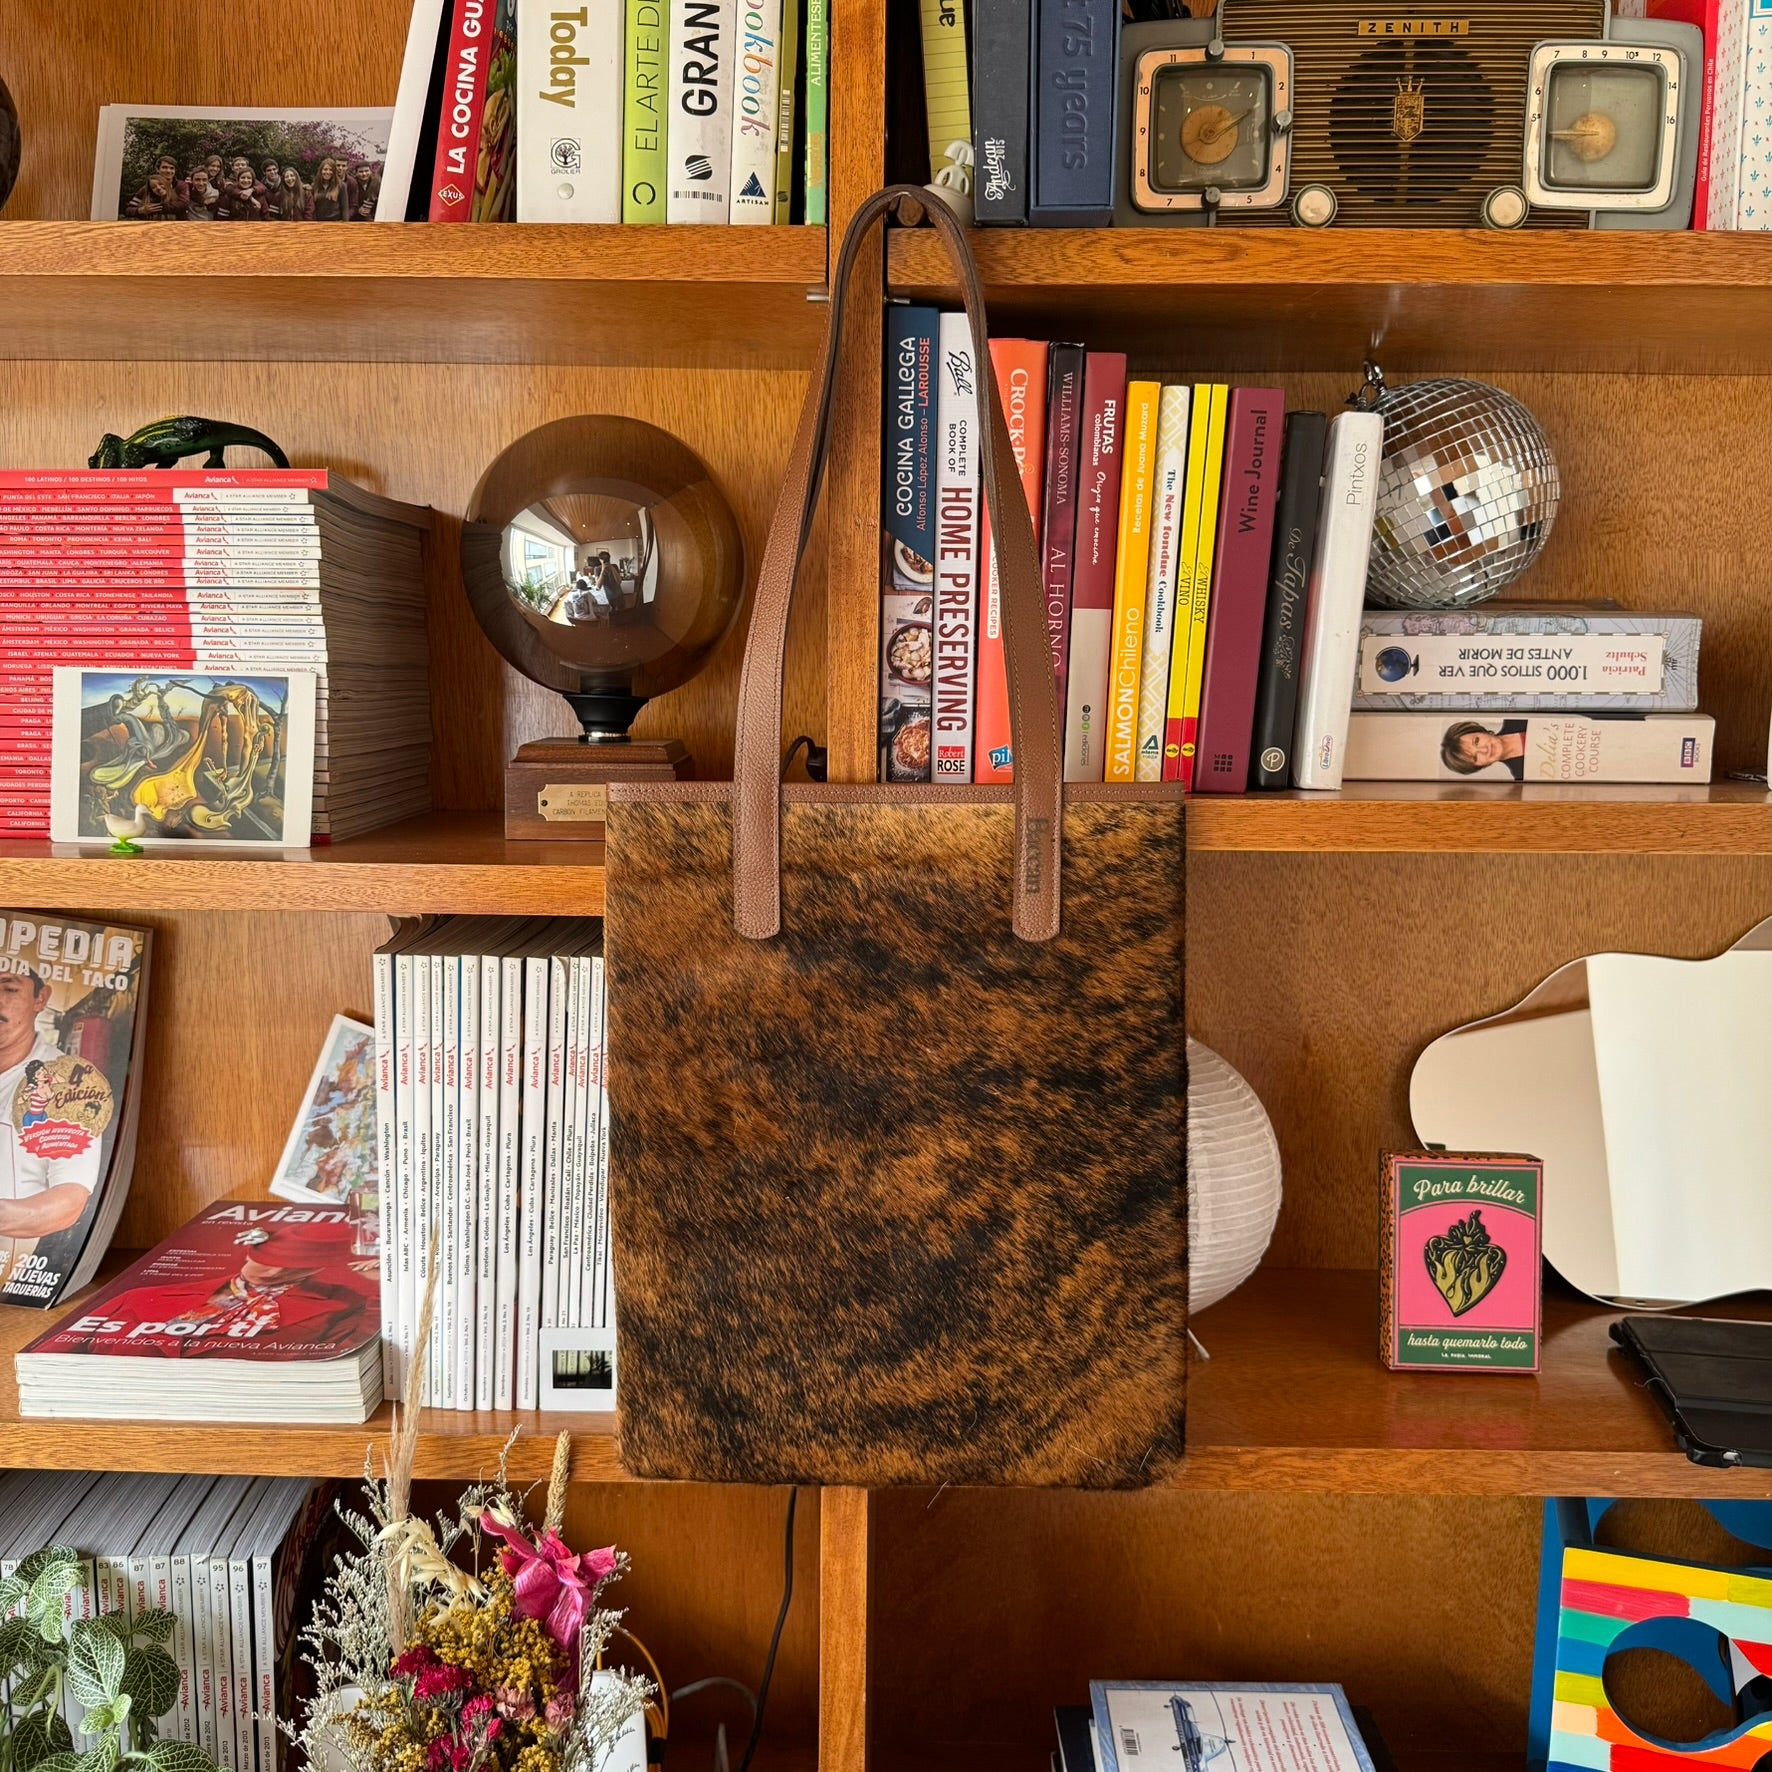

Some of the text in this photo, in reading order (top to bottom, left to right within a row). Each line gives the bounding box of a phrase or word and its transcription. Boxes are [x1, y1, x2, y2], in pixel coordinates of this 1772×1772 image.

[1368, 22, 1461, 33] ZENITH
[539, 6, 590, 109] Today
[681, 2, 720, 117] GRAN
[1170, 54, 1177, 62] 11
[1582, 50, 1588, 58] 8
[1601, 50, 1608, 58] 9
[1652, 53, 1662, 61] 12
[447, 0, 484, 175] LA COCINA GU
[635, 0, 660, 151] EL ARTE D
[1278, 82, 1285, 90] 2
[1668, 81, 1677, 90] 14
[1052, 15, 1094, 171] 75 years
[1140, 87, 1150, 95] 10
[1535, 87, 1541, 95] 6
[1139, 127, 1146, 137] 9
[1666, 115, 1675, 124] 16
[995, 139, 1006, 160] 2015
[983, 137, 1016, 201] Andean
[1139, 168, 1145, 177] 8
[1275, 164, 1281, 173] 4
[1166, 198, 1173, 206] 7
[1246, 195, 1252, 204] 5
[946, 350, 973, 397] Ball
[916, 337, 930, 531] Alfonso López Alonso LAROUSSE
[1010, 368, 1029, 475] CROCK·P
[1102, 400, 1116, 454] FRUTAS
[948, 423, 957, 473] BOOK OF
[958, 419, 967, 476] COMPLETE
[1056, 372, 1073, 505] WILLIAMS-SONOMA
[1092, 413, 1101, 467] colombianas
[205, 476, 231, 484] Avianca
[896, 437, 914, 517] COCINA
[1132, 402, 1149, 534] Recetas de Juana Muzard
[1166, 469, 1176, 491] The
[1238, 409, 1267, 534] Wine Journal
[1346, 441, 1368, 506] Pintxos
[1090, 471, 1106, 504] Origen
[1163, 493, 1175, 522] New
[1050, 547, 1066, 573] AL
[1178, 577, 1192, 606] VINO
[1193, 577, 1208, 625] WHISKY
[1275, 553, 1306, 630] Tapas
[936, 487, 972, 732] HOME PRESERVING
[989, 597, 999, 637] RECIPES
[1155, 580, 1168, 633] Cookbook
[1458, 648, 1573, 660] ANTES DE MORIR
[1605, 651, 1647, 662] Schultz
[1438, 663, 1588, 680] 1.000 SITIOS QUE VER
[1602, 665, 1646, 676] Patricia
[938, 748, 966, 759] Robert
[991, 750, 1012, 767] pil
[1536, 723, 1560, 779] Delia's
[1561, 722, 1575, 780] COMPLETE
[1575, 725, 1588, 777] COOKERY
[1589, 729, 1602, 773] COURSE
[1683, 740, 1694, 765] BBC
[937, 759, 966, 773] ROSE
[0, 918, 133, 973] PEDIA
[38, 963, 73, 983] DEL
[82, 969, 128, 991] TACO
[1413, 1174, 1526, 1204] Para brillar
[15, 1252, 48, 1271] 200
[8, 1267, 61, 1286] NUEVAS
[2, 1280, 54, 1299] TAQUERÍAS
[66, 1315, 272, 1338] Es por ti
[54, 1334, 163, 1348] Bienvenidos
[182, 1339, 202, 1349] la
[207, 1341, 260, 1350] nueva
[264, 1340, 336, 1350] Avianca
[1407, 1333, 1528, 1350] hasta quemarlo todo
[133, 1564, 145, 1572] 87
[173, 1558, 185, 1566] 88
[212, 1564, 224, 1572] 95
[256, 1562, 268, 1570] 97
[238, 1677, 248, 1711] Avianca
